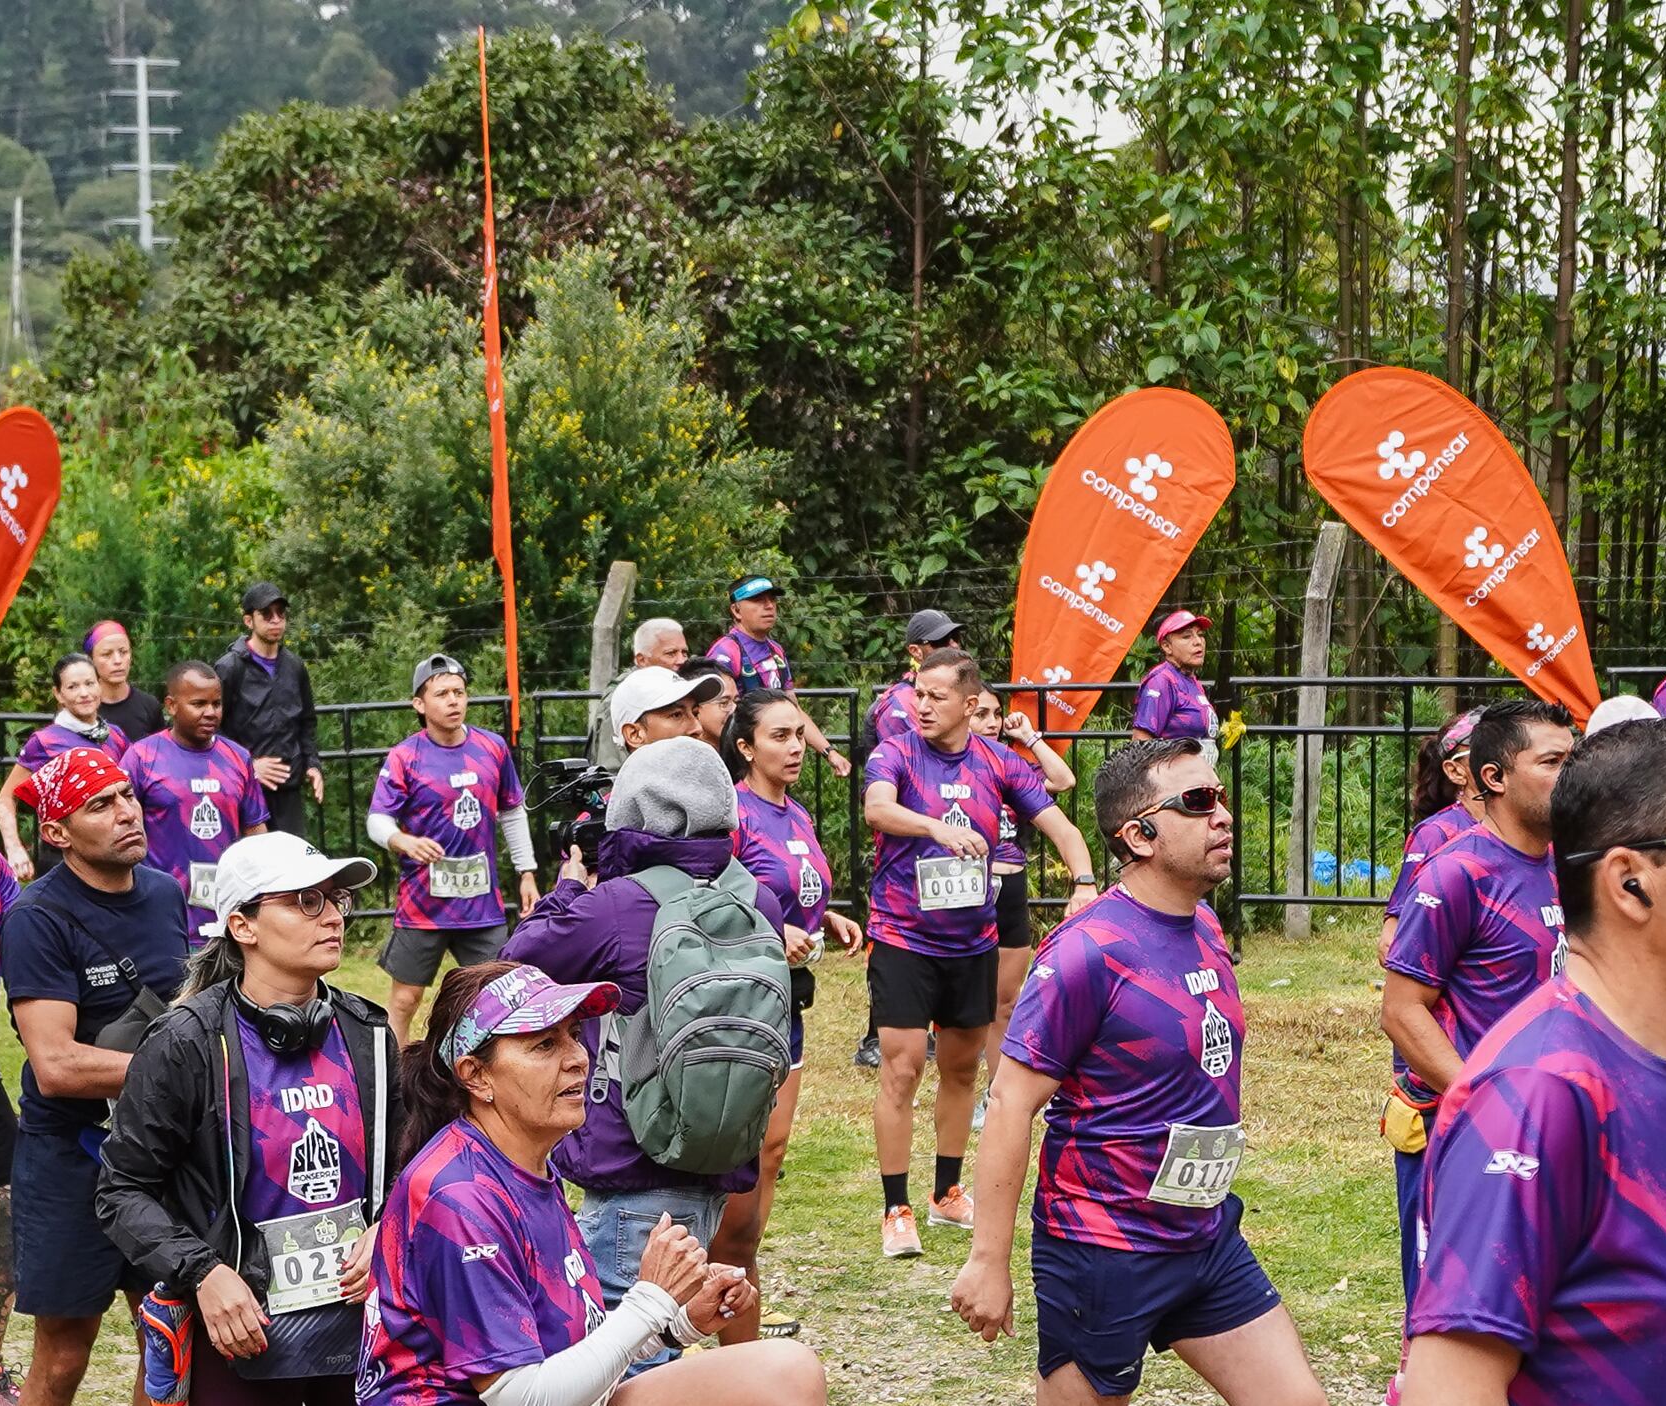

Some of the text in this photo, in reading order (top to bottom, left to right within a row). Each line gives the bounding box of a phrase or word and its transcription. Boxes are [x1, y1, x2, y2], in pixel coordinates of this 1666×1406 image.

[1382, 432, 1469, 527] compensar
[1081, 470, 1182, 539] compensar
[1467, 528, 1540, 606] compensar
[1039, 576, 1124, 633] compensar
[1527, 624, 1577, 676] compensar
[940, 784, 971, 799] IDRD
[930, 877, 979, 897] 0018
[1540, 904, 1565, 927] IDR
[1185, 968, 1220, 995] IDRD
[280, 1084, 333, 1113] IDRD
[284, 1243, 351, 1285] 023
